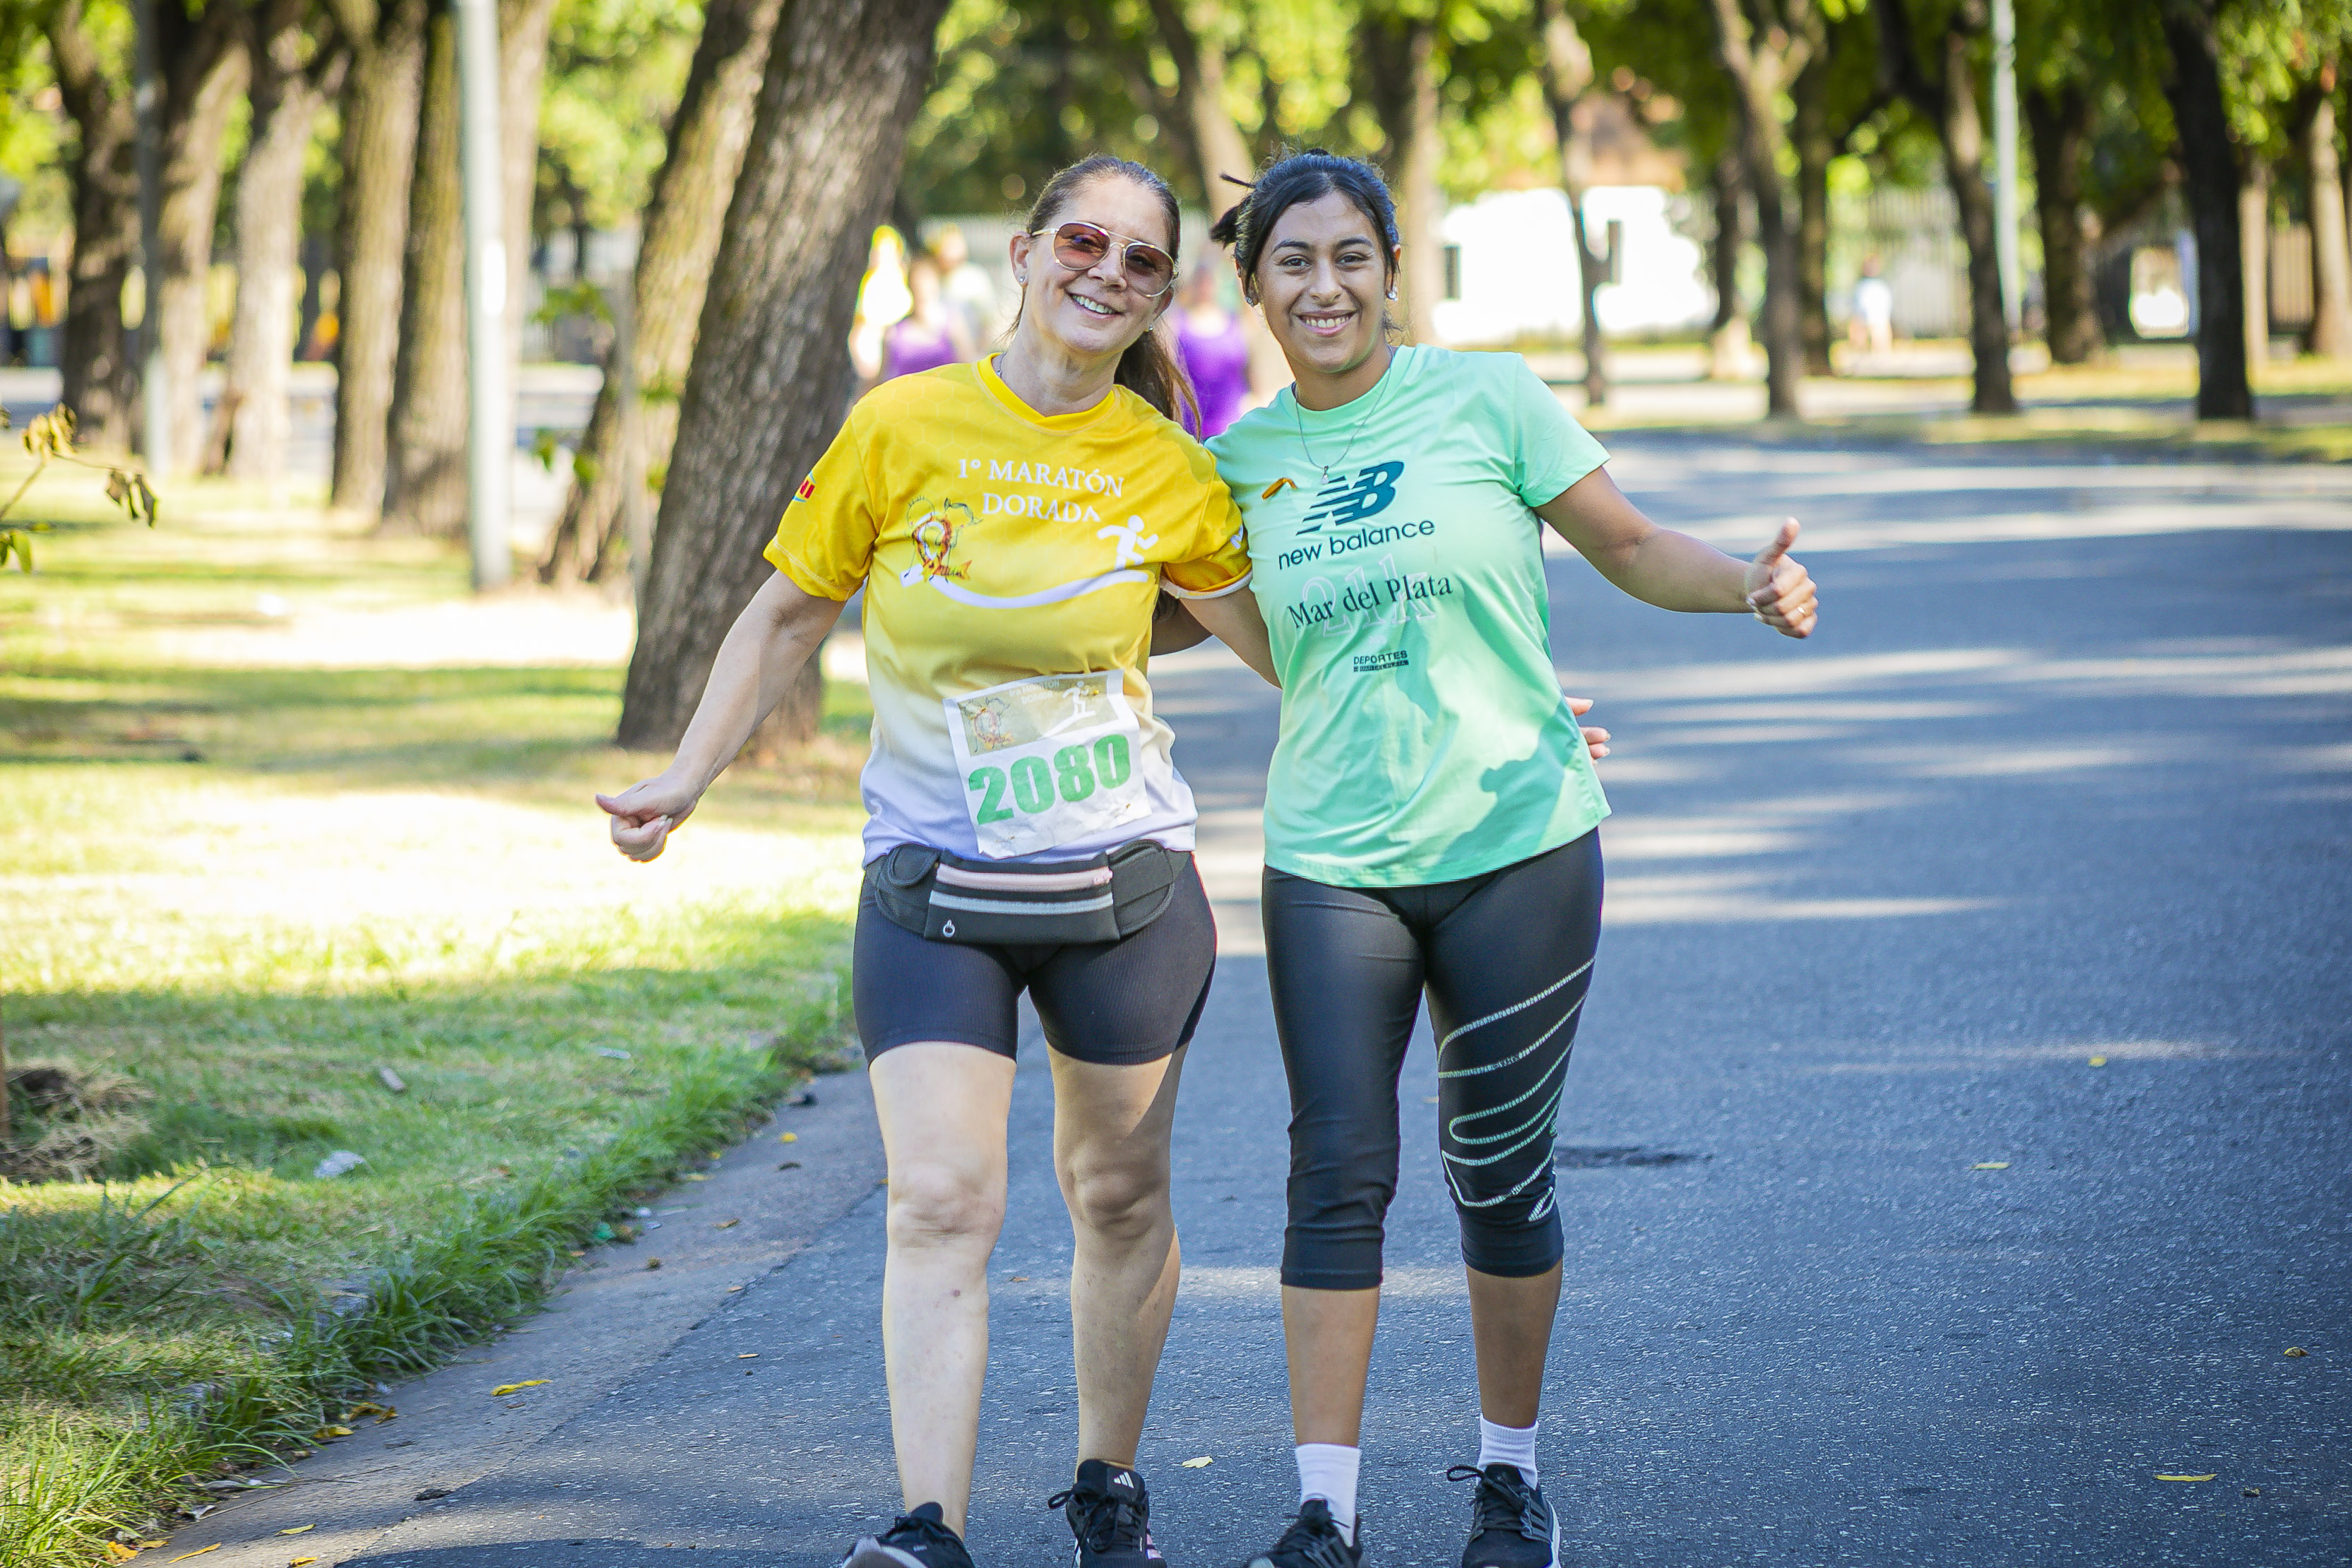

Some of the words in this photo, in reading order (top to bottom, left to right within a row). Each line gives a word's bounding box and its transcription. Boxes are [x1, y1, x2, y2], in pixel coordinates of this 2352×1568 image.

[988, 459, 1124, 497] MARATÓN
[982, 492, 1101, 523] DORADA
[1278, 543, 1323, 571] new
[1329, 520, 1435, 556] balance
[1287, 600, 1334, 629] Mar
[1343, 581, 1381, 613] del
[1384, 574, 1454, 602] Plata
[1353, 650, 1408, 665] DEPORTES
[968, 733, 1132, 826] 2080
